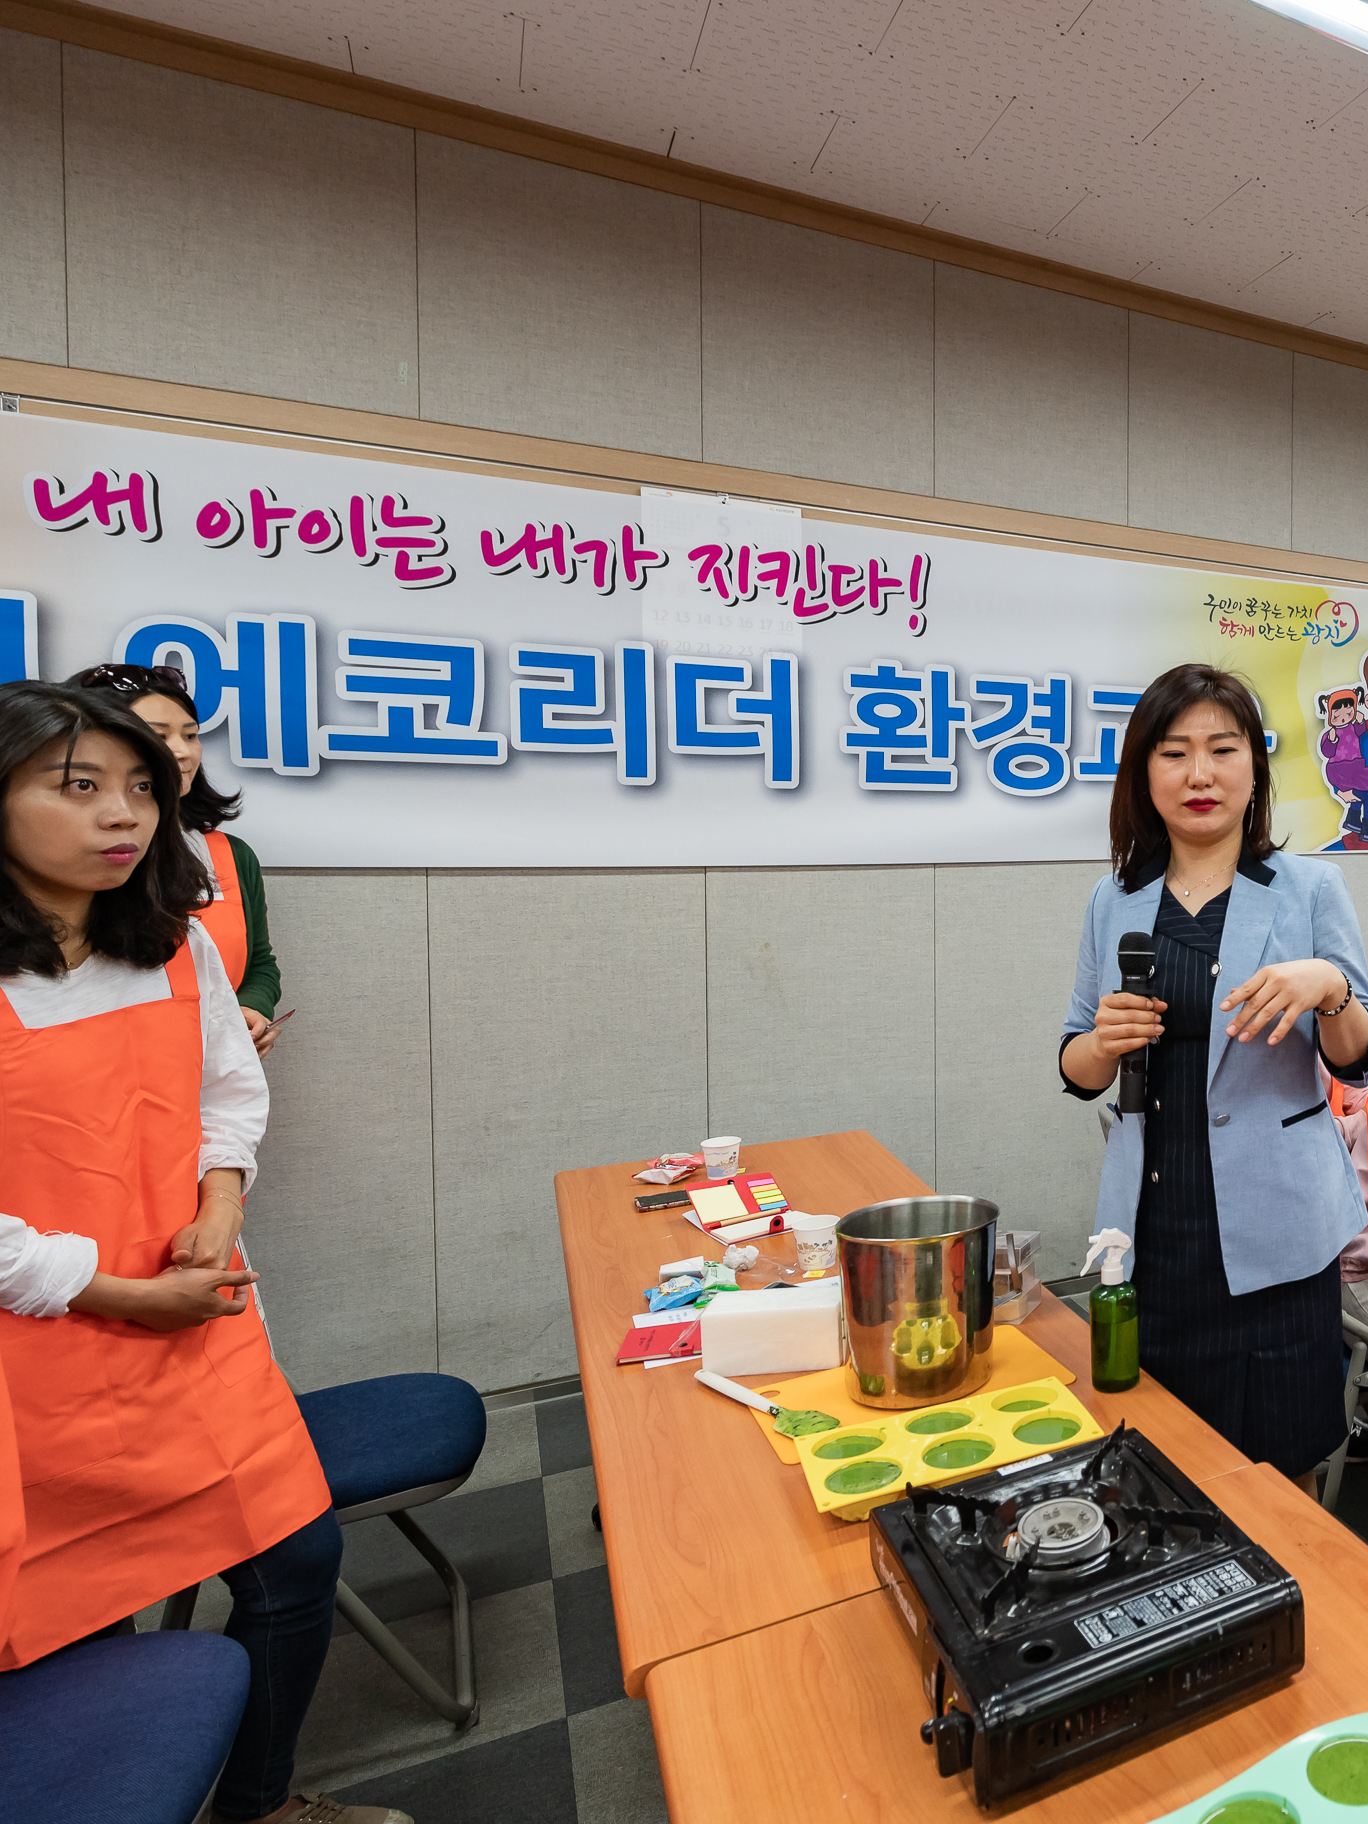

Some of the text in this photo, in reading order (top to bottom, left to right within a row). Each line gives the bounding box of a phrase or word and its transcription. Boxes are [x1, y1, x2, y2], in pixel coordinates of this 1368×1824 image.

[31, 468, 158, 540] 내
[196, 488, 456, 589] 아이는
[480, 521, 668, 595] 내가
[687, 543, 932, 636] 지킨다!
[1203, 593, 1313, 622] 구민이 꿈꾸는 가치
[1219, 616, 1255, 639] 함께
[1258, 623, 1302, 641] 만드는
[121, 618, 798, 785] 에코리더
